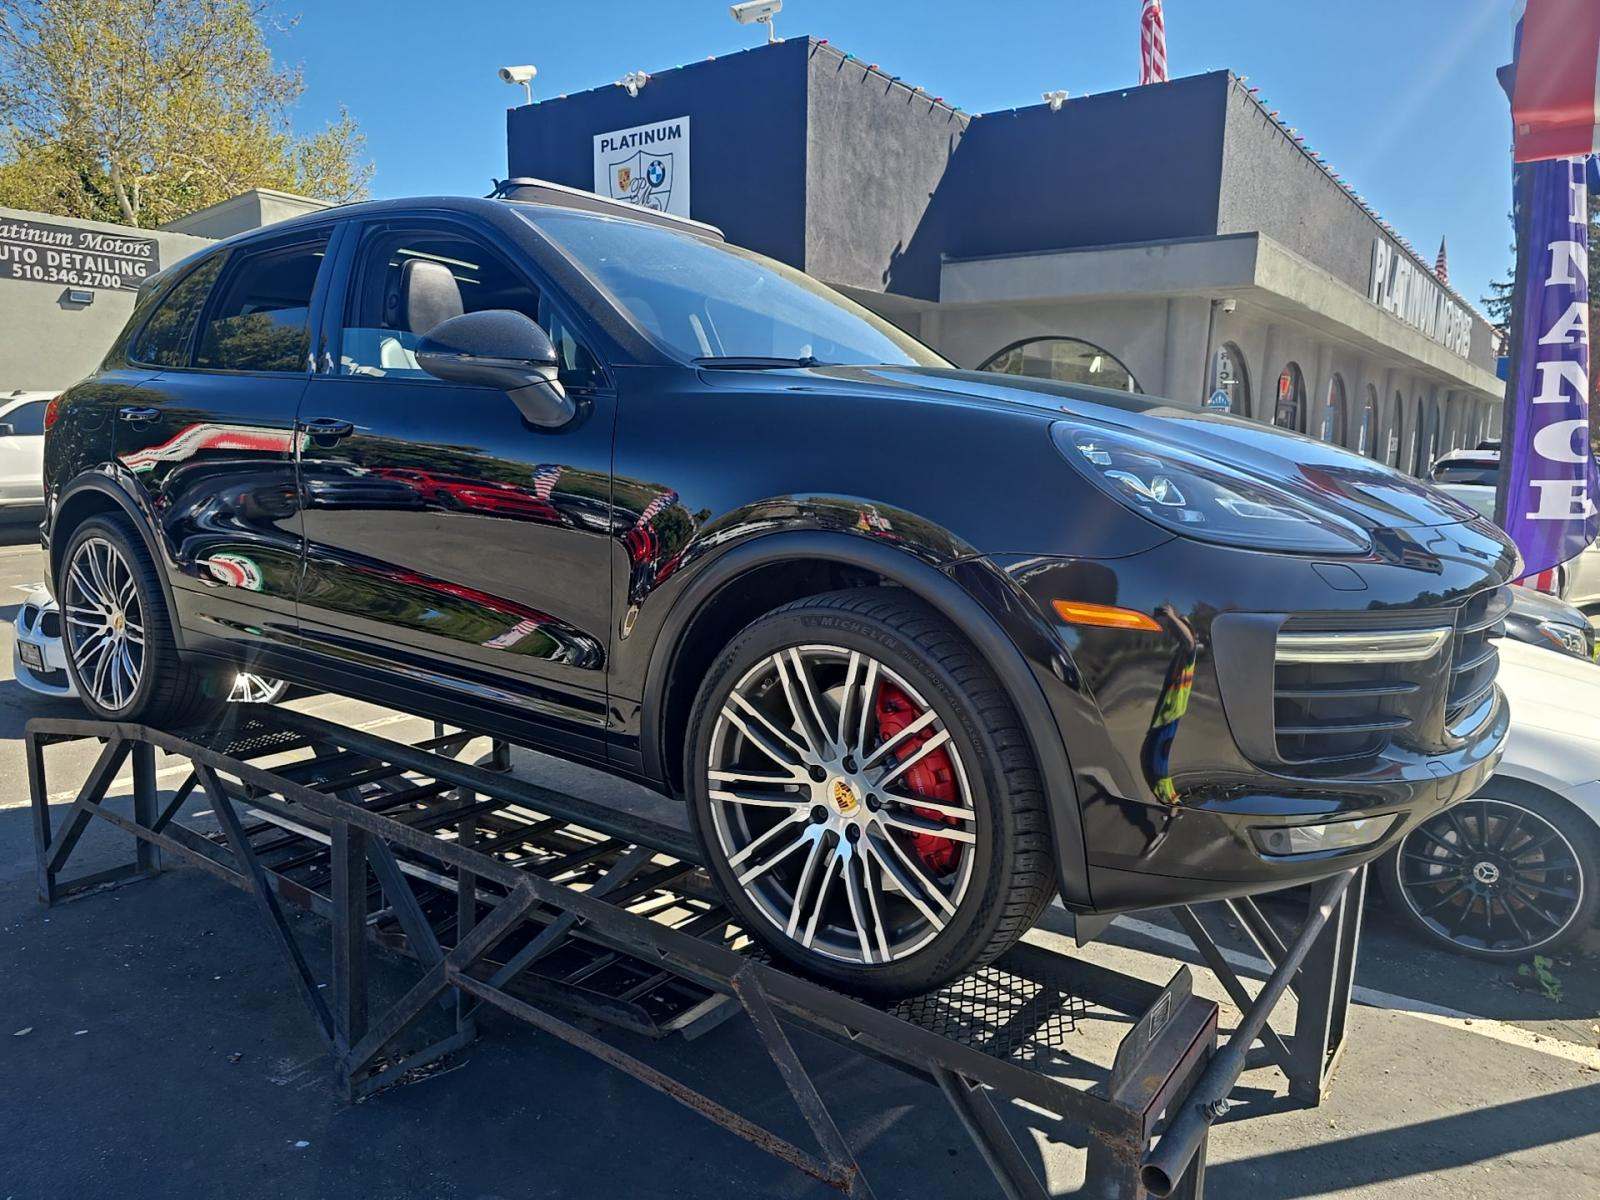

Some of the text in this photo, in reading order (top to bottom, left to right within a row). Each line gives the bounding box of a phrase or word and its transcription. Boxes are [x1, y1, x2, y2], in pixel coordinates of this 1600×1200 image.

[601, 124, 682, 153] PLATINUM
[0, 221, 151, 257] atinum Motors
[12, 263, 122, 288] 510.346.2700
[47, 251, 147, 277] DETAILING
[821, 616, 898, 650] MICHELIN
